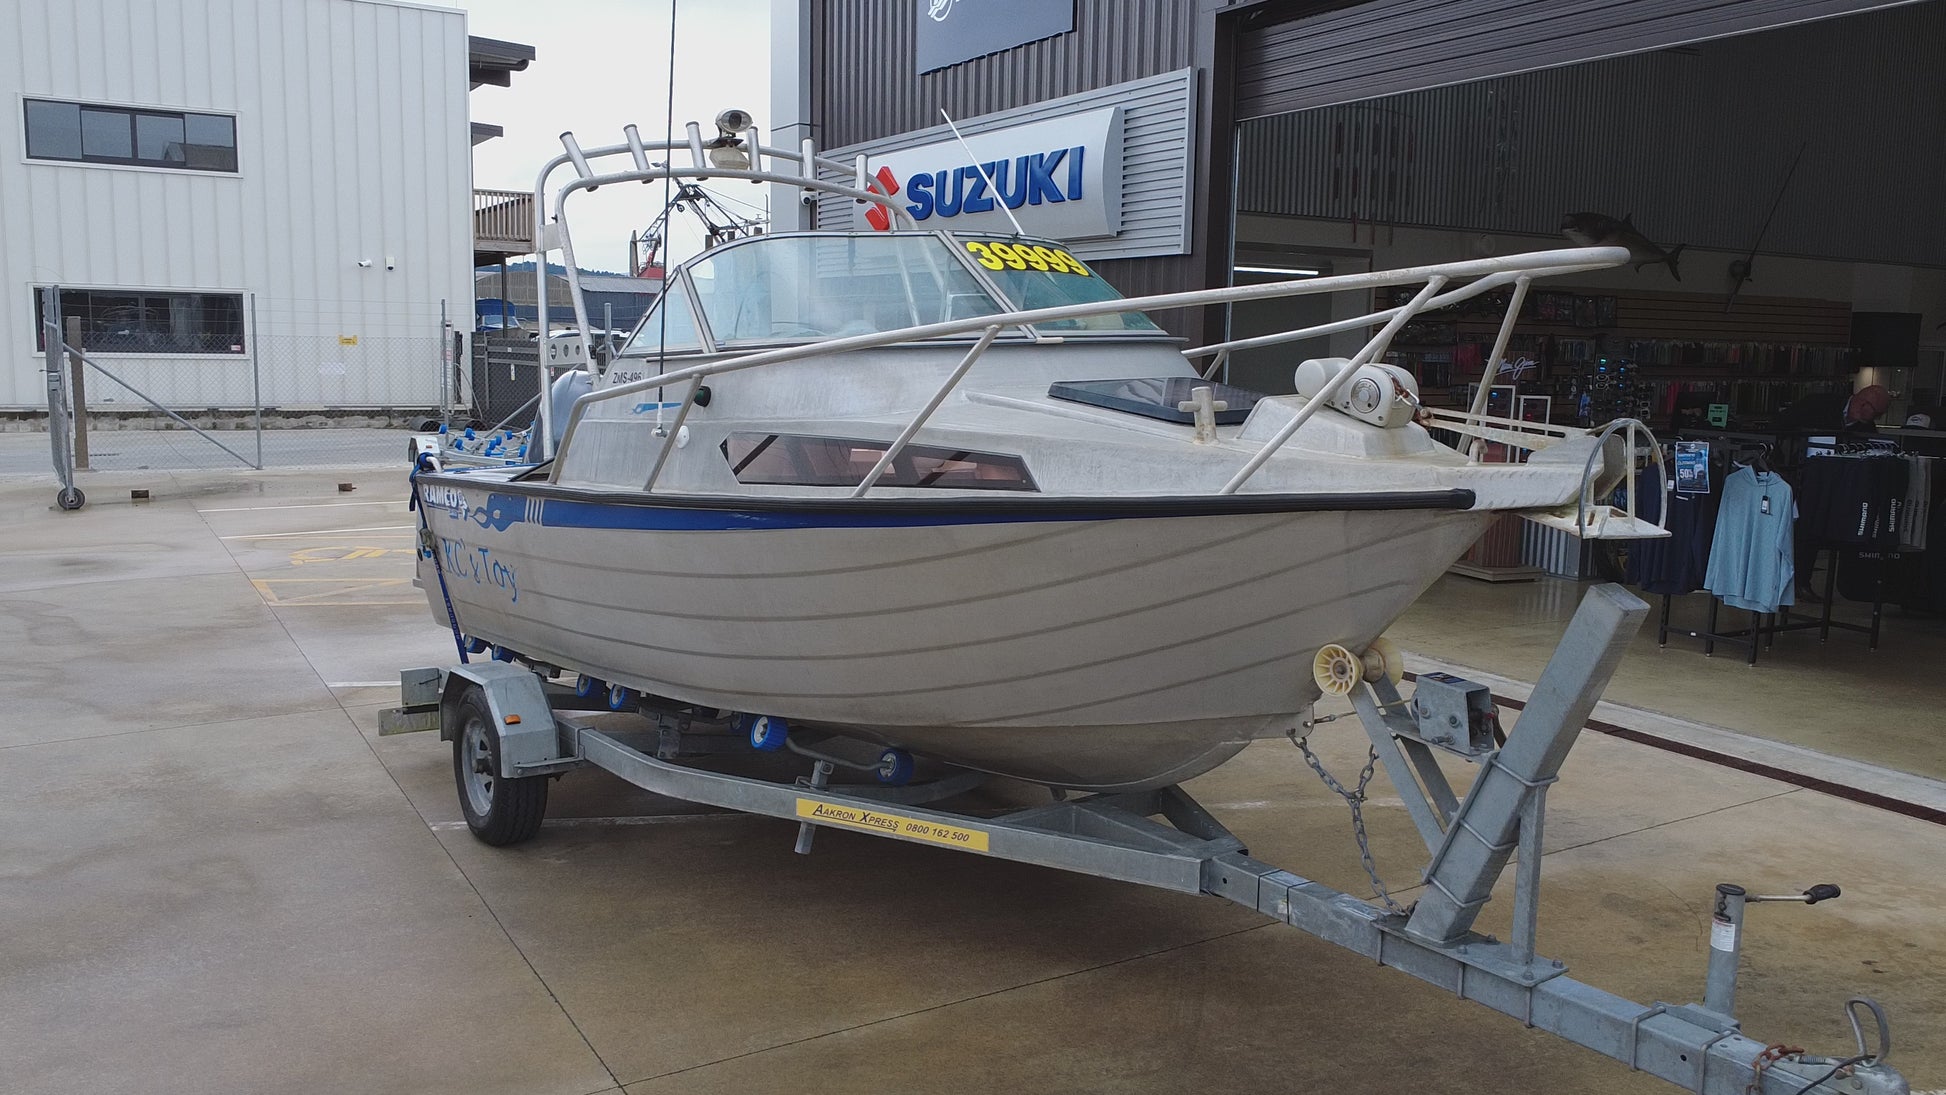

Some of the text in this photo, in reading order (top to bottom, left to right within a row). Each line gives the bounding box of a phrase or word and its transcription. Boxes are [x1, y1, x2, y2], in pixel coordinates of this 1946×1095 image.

[906, 145, 1085, 221] SUZUKI
[966, 241, 1090, 277] 39999
[905, 823, 930, 835] 0800
[932, 828, 950, 839] 162
[951, 832, 970, 842] 500
